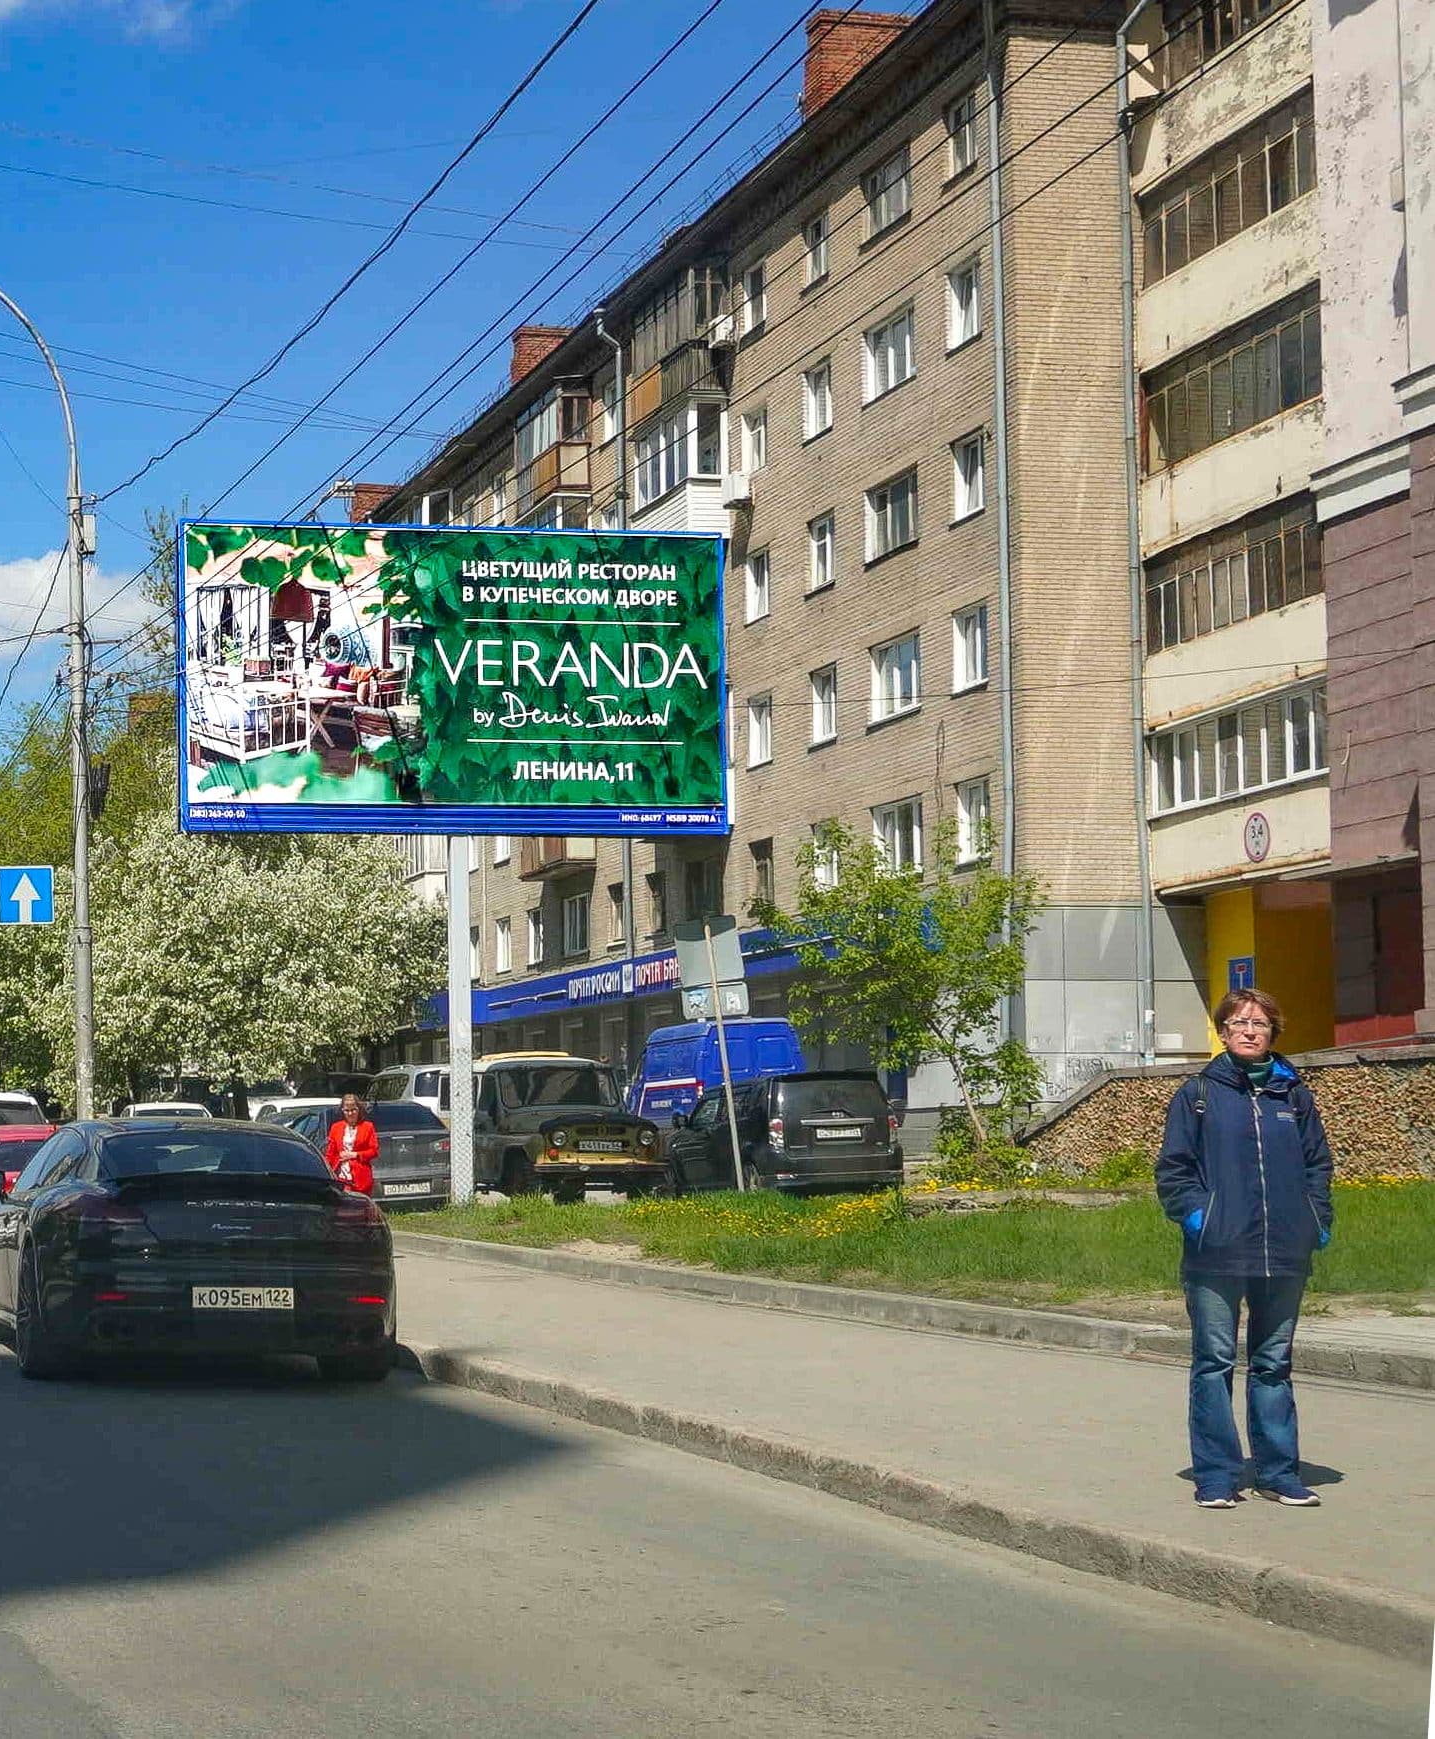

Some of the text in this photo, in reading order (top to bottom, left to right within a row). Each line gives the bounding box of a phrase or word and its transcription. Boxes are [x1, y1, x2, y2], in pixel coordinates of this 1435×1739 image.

[462, 559, 676, 582] ЦВЕТУЩИЙ РЕСТОРАН
[462, 586, 678, 609] В КУПЕЧЕСКОМ ДВОРЕ
[433, 638, 708, 689] VERANDA
[473, 708, 495, 728] by
[499, 691, 584, 728] Denis
[513, 760, 634, 783] ЛЕНИНА,11
[635, 956, 681, 987] ПОЧТА БАН
